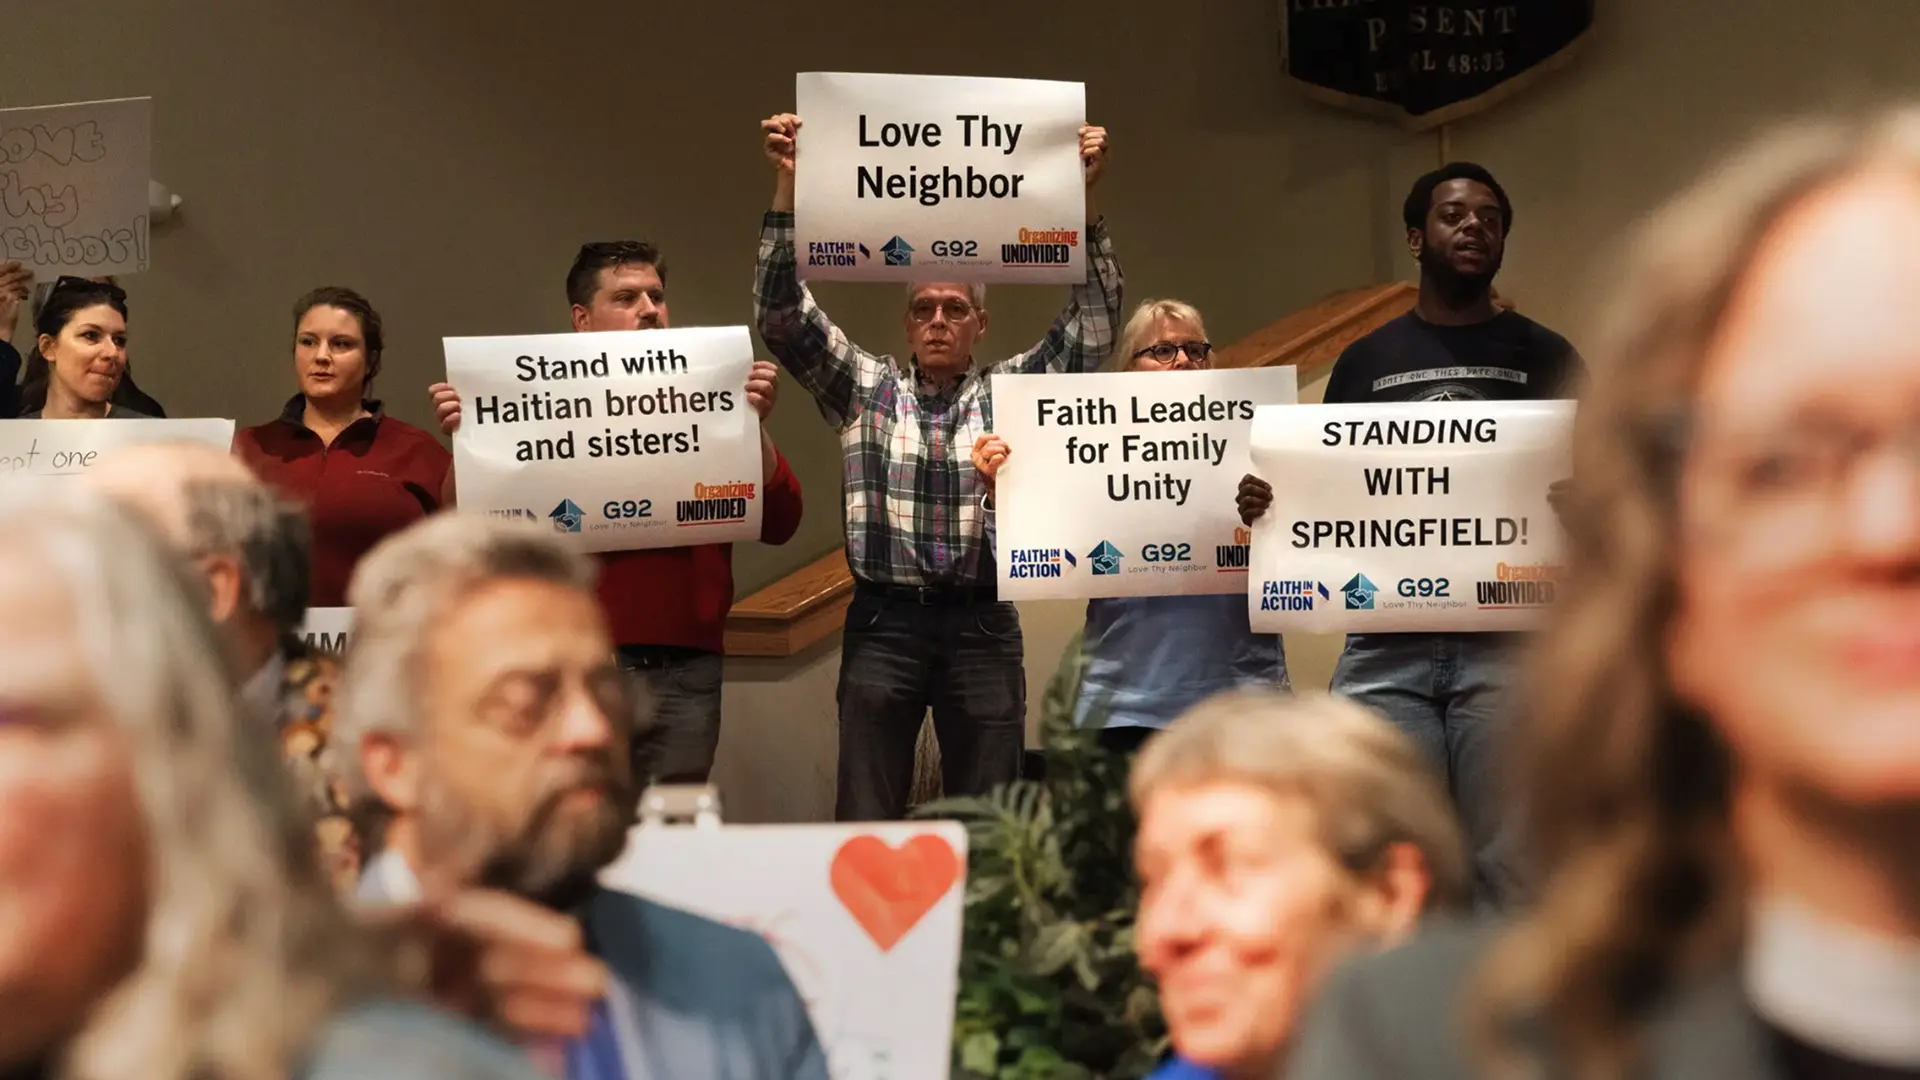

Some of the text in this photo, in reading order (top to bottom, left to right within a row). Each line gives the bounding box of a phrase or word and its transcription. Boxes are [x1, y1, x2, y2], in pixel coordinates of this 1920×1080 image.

[1366, 7, 1518, 53] PSENT
[0, 120, 106, 166] ove
[858, 114, 1023, 155] Love Thy
[857, 165, 1025, 206] Neighbor
[1018, 226, 1079, 247] Organizing
[808, 241, 856, 254] FAITH IN
[931, 240, 978, 257] G92
[1001, 243, 1070, 264] UNDIVIDED
[808, 254, 856, 267] ACTION
[515, 349, 689, 382] Stand with
[1376, 368, 1521, 388] ADMIT ONE THIS DATE ONLY
[475, 386, 735, 425] Haitian brothers
[1037, 394, 1254, 426] Faith Leaders
[1322, 417, 1498, 447] STANDING
[515, 424, 701, 462] and sisters!
[1065, 432, 1228, 466] for Family
[52, 450, 98, 468] one
[694, 480, 756, 501] Organizing
[1107, 472, 1192, 506] Unity
[1363, 466, 1450, 496] WITH
[603, 498, 653, 520] G92
[676, 497, 747, 523] UNDIVIDED
[613, 521, 628, 530] Thy
[1290, 517, 1529, 549] SPRINGFIELD!
[1010, 548, 1061, 563] FAITH IN
[1141, 542, 1192, 562] G92
[1216, 545, 1251, 568] UNDI
[1009, 563, 1061, 579] ACTION
[1128, 563, 1208, 574] Love Thy Neighbor
[1262, 580, 1313, 595] FAITH IN
[1397, 577, 1451, 598] G92
[1260, 595, 1313, 611] ACTION
[1382, 600, 1467, 609] Love Thy Neighbor
